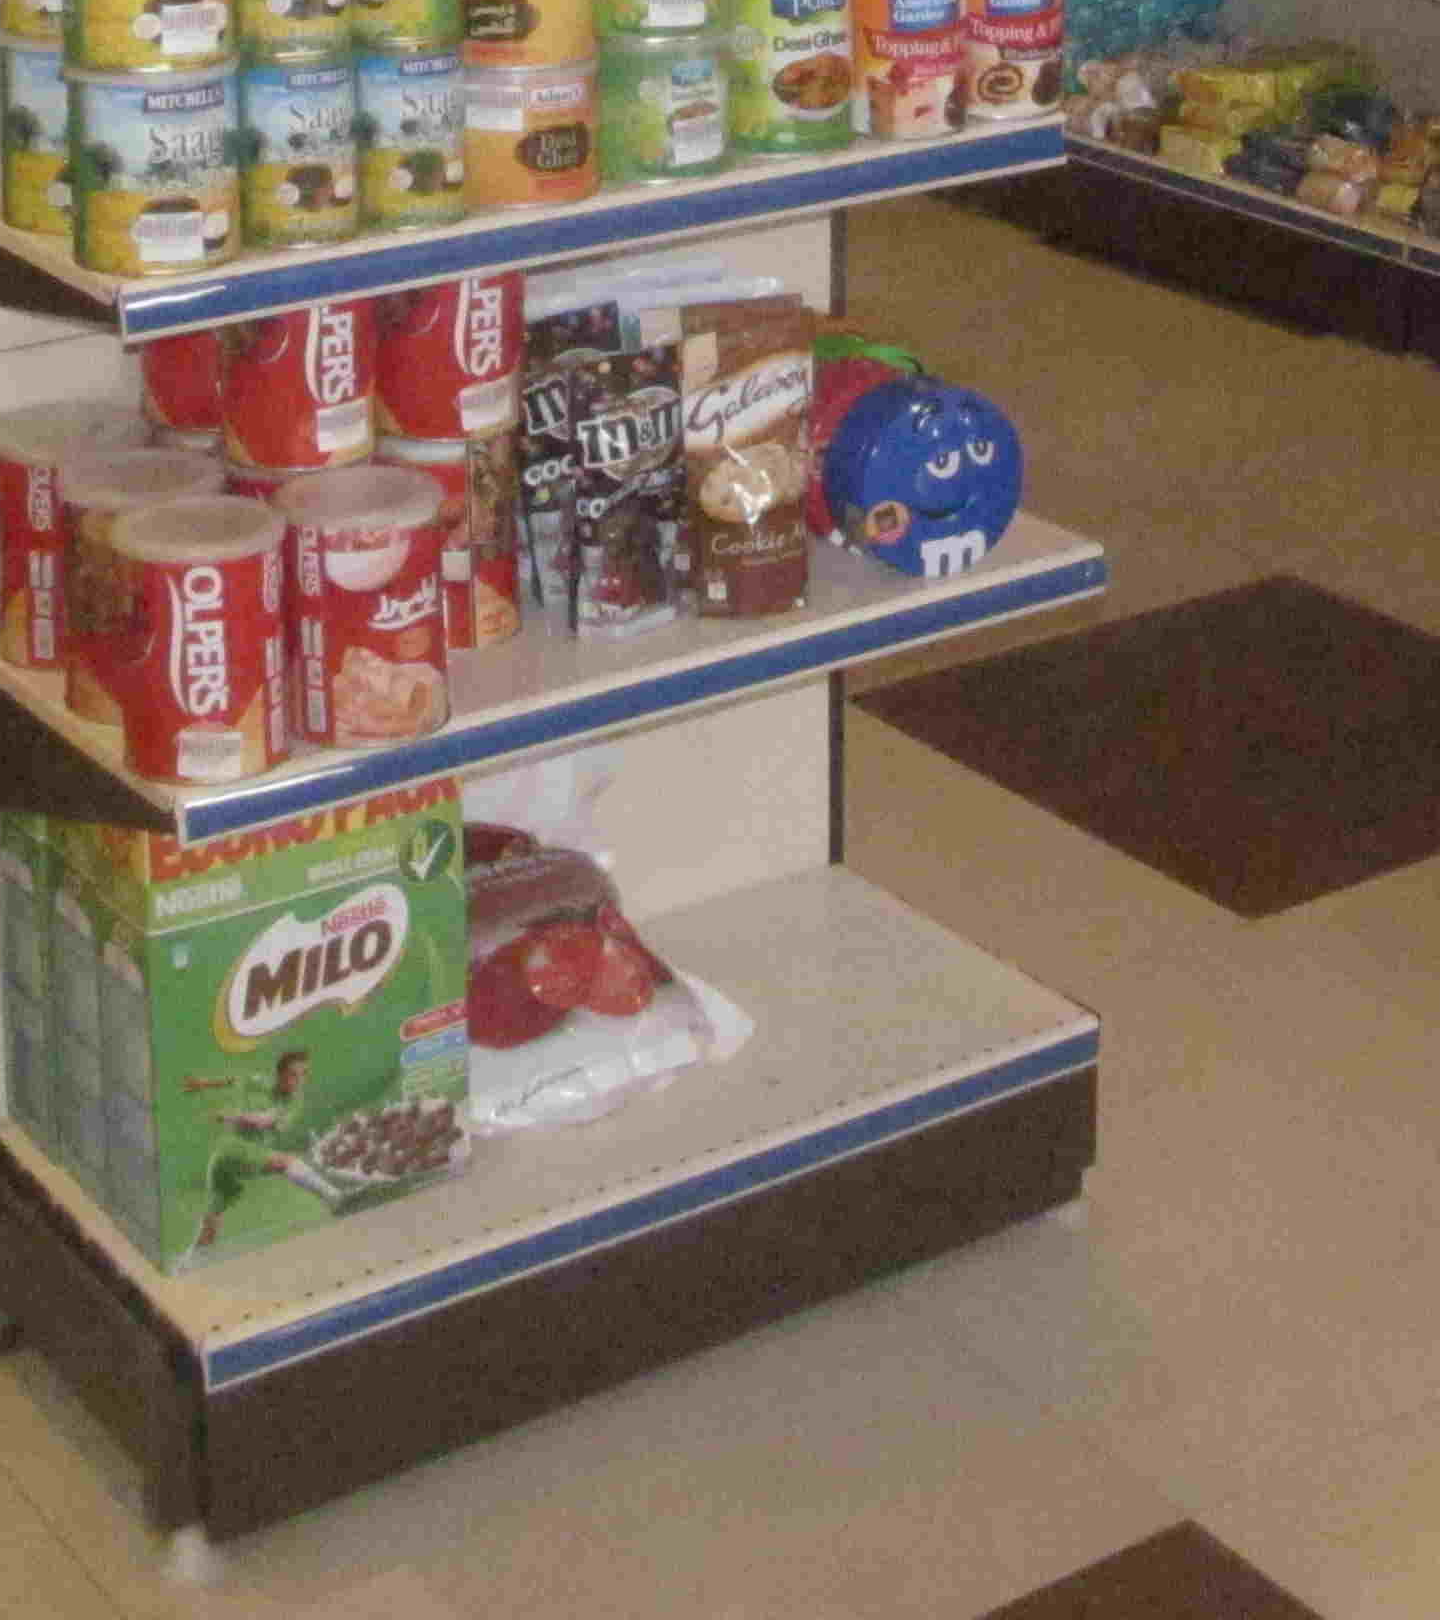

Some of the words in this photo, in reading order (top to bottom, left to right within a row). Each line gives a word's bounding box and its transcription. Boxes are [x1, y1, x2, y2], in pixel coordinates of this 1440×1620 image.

[892, 7, 947, 25] Garden
[970, 17, 1033, 43] Topping
[873, 34, 933, 59] Topping
[687, 368, 810, 445] Galaxy
[320, 893, 389, 934] Nestlé
[243, 918, 393, 1020] MILO
